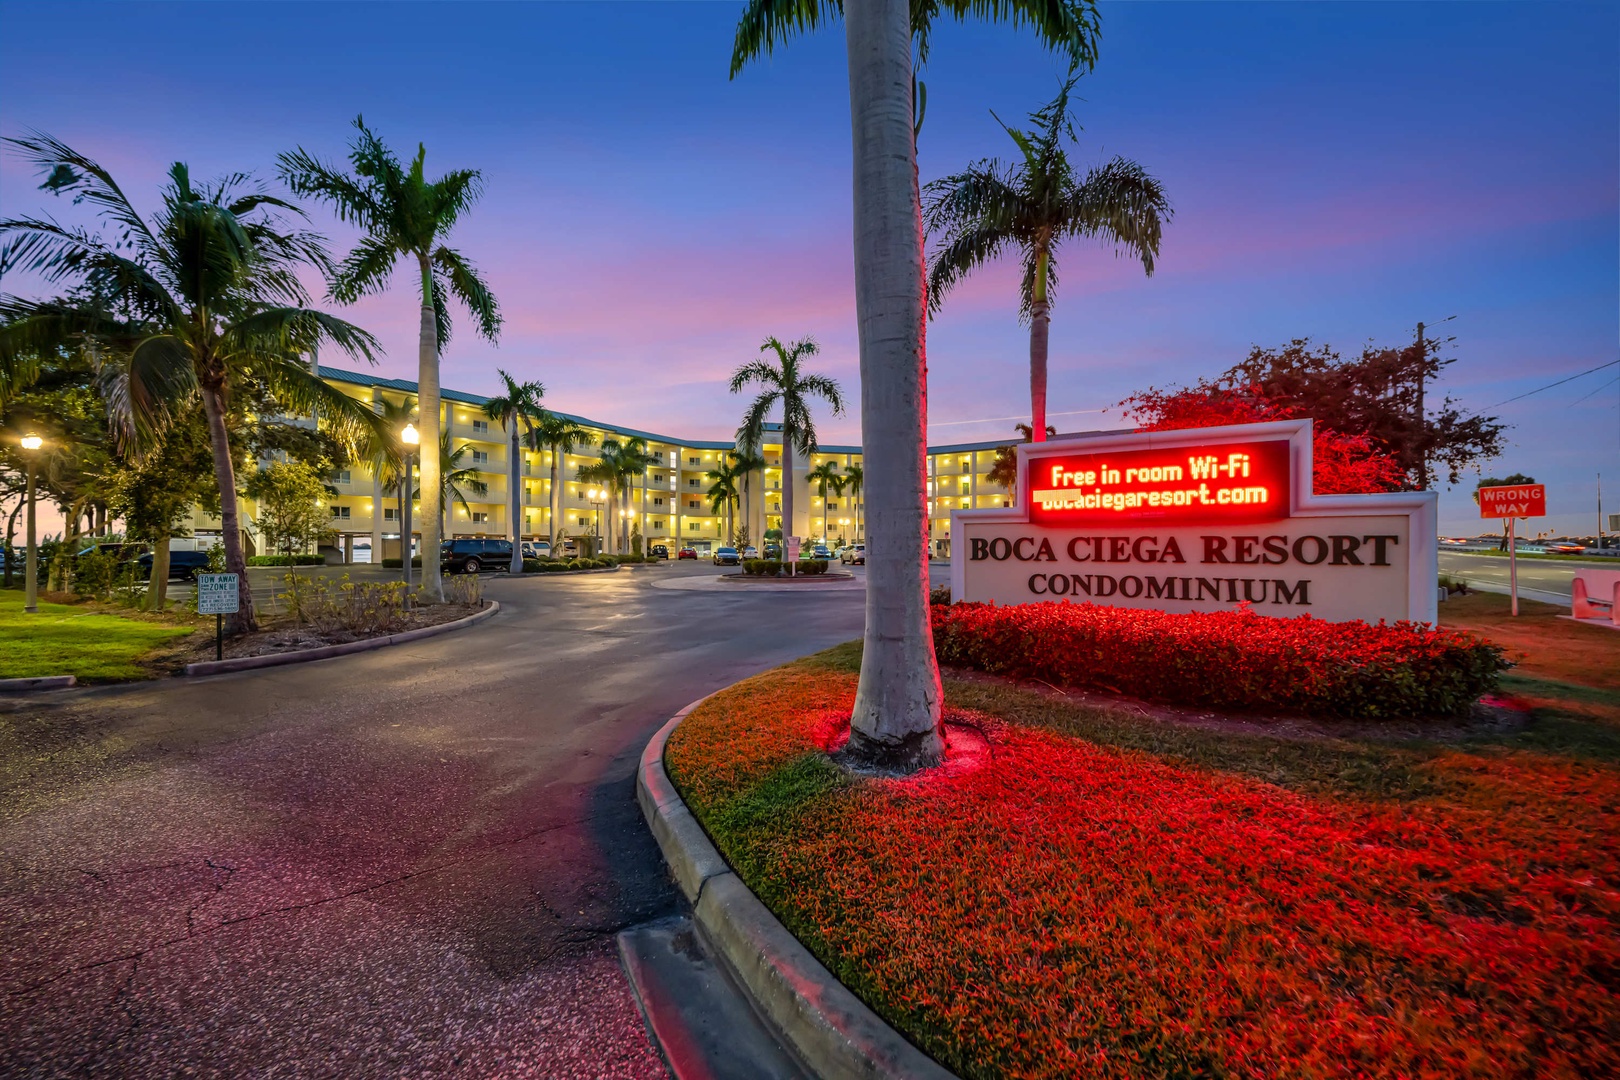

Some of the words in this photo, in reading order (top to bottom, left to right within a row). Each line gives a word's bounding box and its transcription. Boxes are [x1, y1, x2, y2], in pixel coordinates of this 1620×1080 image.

[1052, 466, 1096, 487] Free
[1101, 464, 1120, 485] in
[1126, 465, 1182, 483] room
[1189, 454, 1250, 479] Wi-Fi
[1483, 488, 1541, 501] WRONG
[1495, 503, 1529, 514] WAY
[969, 537, 1058, 562] BOCA
[1067, 536, 1186, 563] CIEGA
[1200, 535, 1399, 566] RESORT
[1028, 573, 1312, 605] CONDOMINIUM
